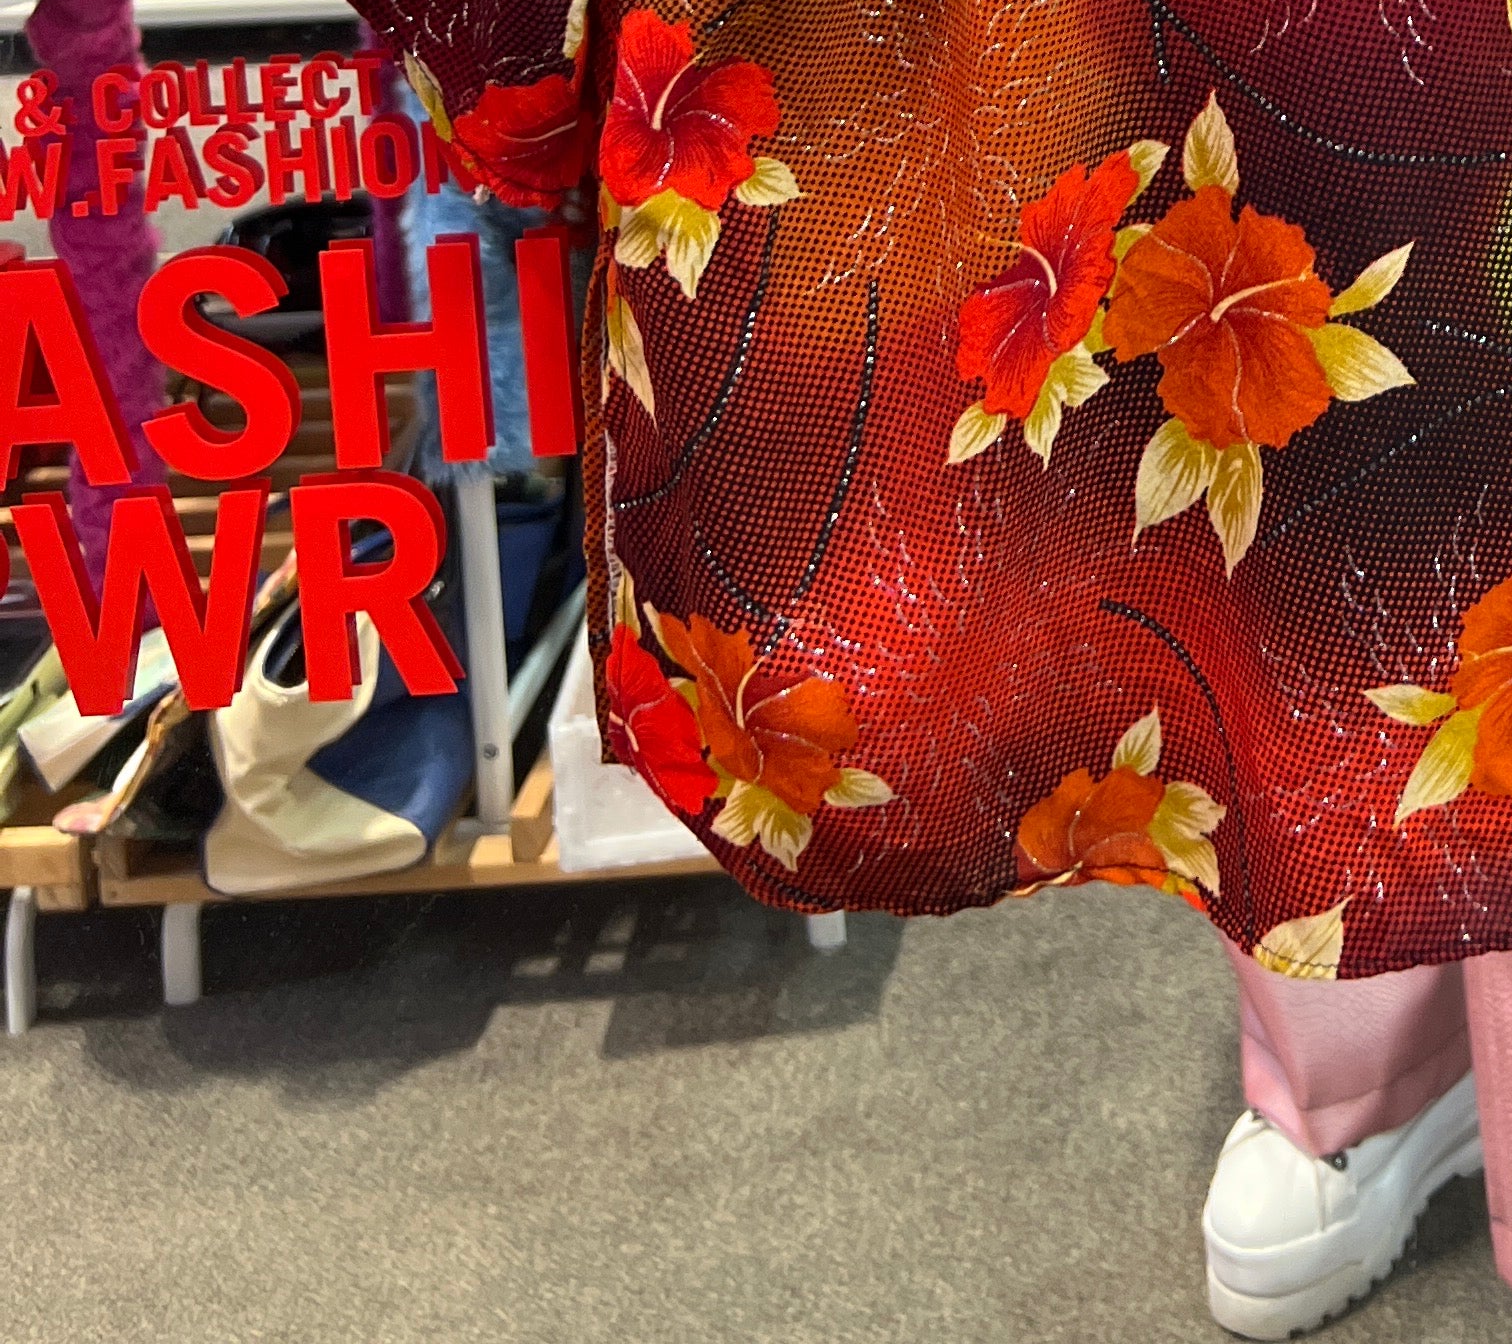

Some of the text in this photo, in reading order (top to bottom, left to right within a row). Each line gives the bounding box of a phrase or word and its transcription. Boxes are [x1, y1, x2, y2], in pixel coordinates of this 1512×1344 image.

[15, 58, 381, 137] & COLLECT
[0, 482, 459, 717] WR
